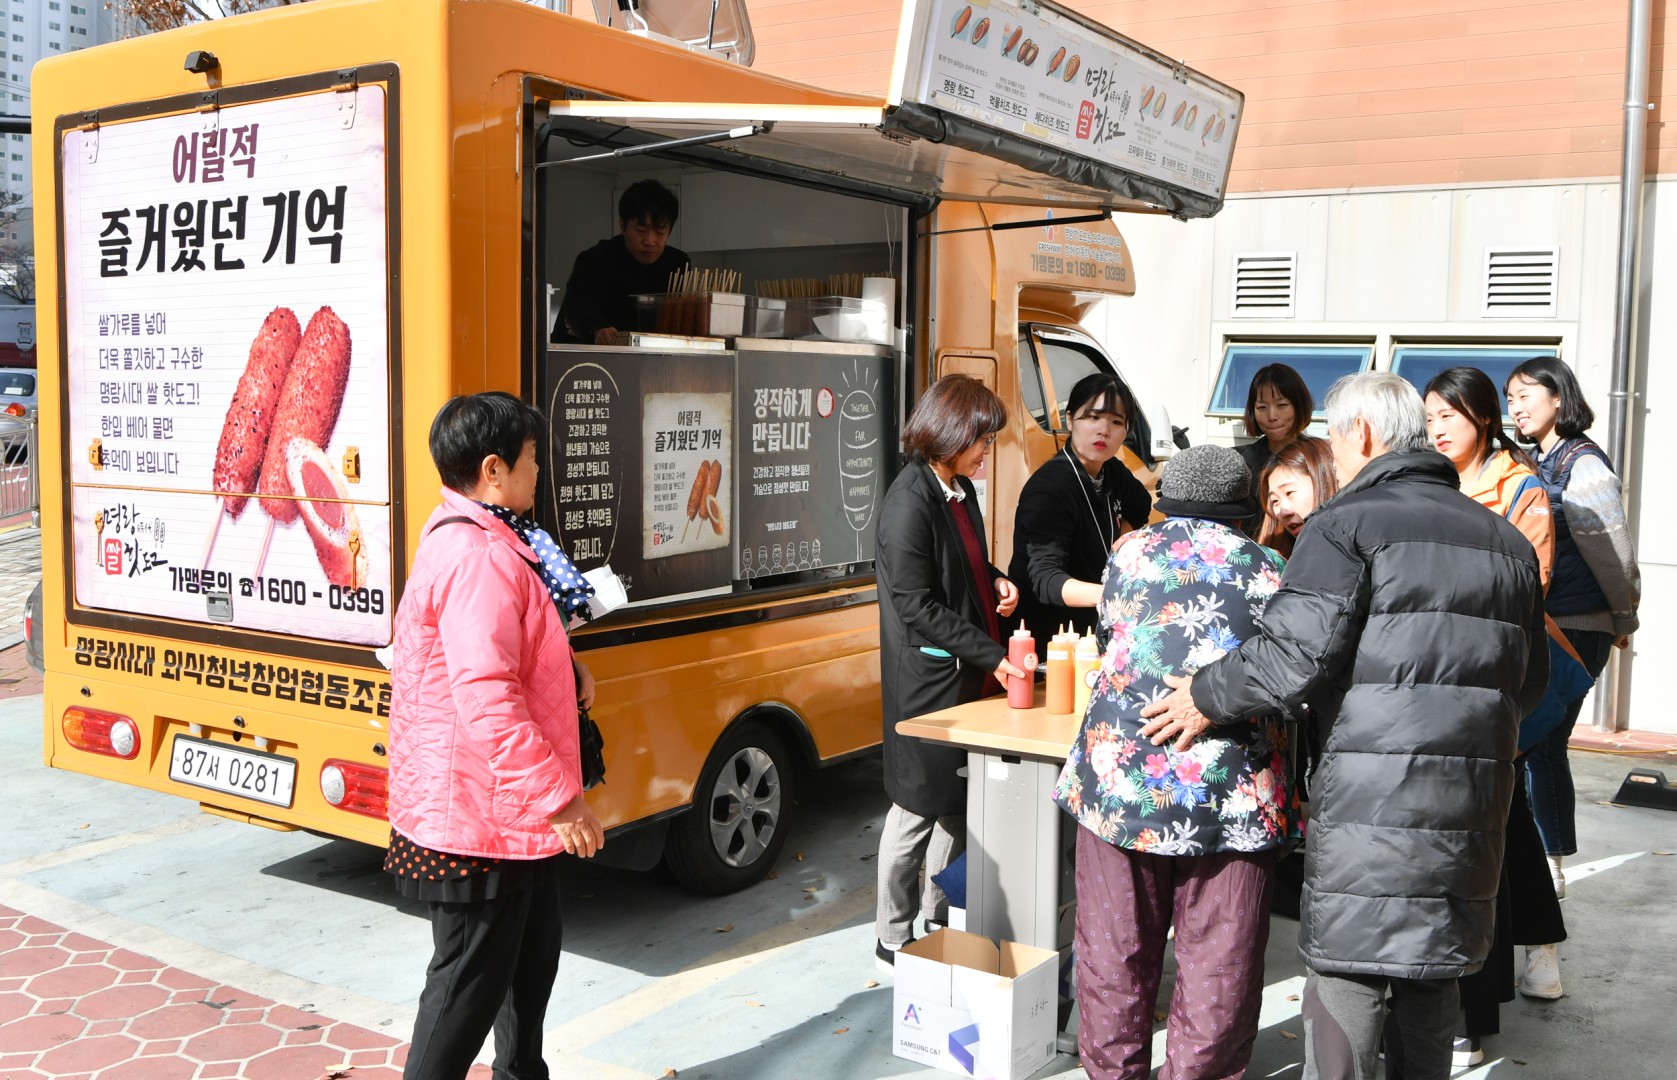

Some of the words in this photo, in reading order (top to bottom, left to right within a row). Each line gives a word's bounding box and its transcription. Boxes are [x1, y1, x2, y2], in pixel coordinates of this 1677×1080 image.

[944, 79, 956, 93] 명랑
[958, 84, 975, 99] 핫도그
[990, 95, 1011, 111] 먹물치즈
[1012, 102, 1027, 117] 핫도그
[1056, 118, 1070, 132] 핫도그
[1077, 102, 1094, 138] 쌀
[172, 123, 259, 183] 어릴적
[98, 195, 248, 277] 즐거웠던
[262, 185, 347, 264] 기억
[1031, 254, 1063, 275] 가맹문의
[1075, 261, 1096, 278] 1600
[1105, 265, 1126, 282] 0399
[99, 313, 140, 336] 쌀가루를
[145, 312, 166, 335] 넣어
[99, 348, 119, 370] 더욱
[123, 347, 165, 370] 쫄깃하고
[170, 346, 204, 370] 구수한
[100, 382, 142, 405] 명랑시대
[147, 382, 158, 405] 쌀
[163, 382, 200, 405] 핫도그!
[565, 393, 575, 404] 더욱
[596, 393, 610, 403] 구수한
[753, 387, 812, 419] 정직하게
[566, 407, 586, 420] 명랑시대
[595, 407, 610, 419] 핫도그
[678, 410, 702, 426] 어릴적
[101, 416, 122, 438] 한입
[126, 416, 148, 439] 베어
[153, 417, 174, 440] 물면
[568, 424, 590, 437] 건강하고
[591, 423, 607, 436] 정직한
[752, 421, 812, 453] 만듭니다
[855, 430, 865, 442] FAIR
[566, 442, 588, 457] 청년들의
[589, 441, 610, 455] 가슴으로
[655, 430, 699, 452] 즐거웠던
[701, 429, 722, 450] 기억
[102, 449, 131, 473] 추억이
[137, 451, 179, 475] 보입니다
[567, 462, 585, 478] 정성껏
[586, 461, 609, 477] 만듭니다
[753, 465, 774, 479] 건강하고
[775, 465, 790, 478] 정직한
[560, 485, 573, 503] 천원
[575, 484, 599, 502] 핫도그에
[601, 483, 614, 500] 담긴
[753, 482, 773, 496] 가슴으로
[773, 481, 789, 494] 정성껏
[103, 502, 140, 535] 명랑
[565, 510, 584, 530] 정성은
[587, 508, 612, 528] 추억만큼
[105, 540, 122, 573] 쌀
[124, 537, 168, 578] 핫도그
[169, 567, 232, 594] 가맹문의
[258, 577, 306, 605] 1600
[329, 584, 385, 615] 0399
[74, 636, 156, 676] 명랑시대
[182, 748, 220, 780] 87서
[229, 758, 279, 795] 0281
[900, 1039, 929, 1053] SAMSUNG
